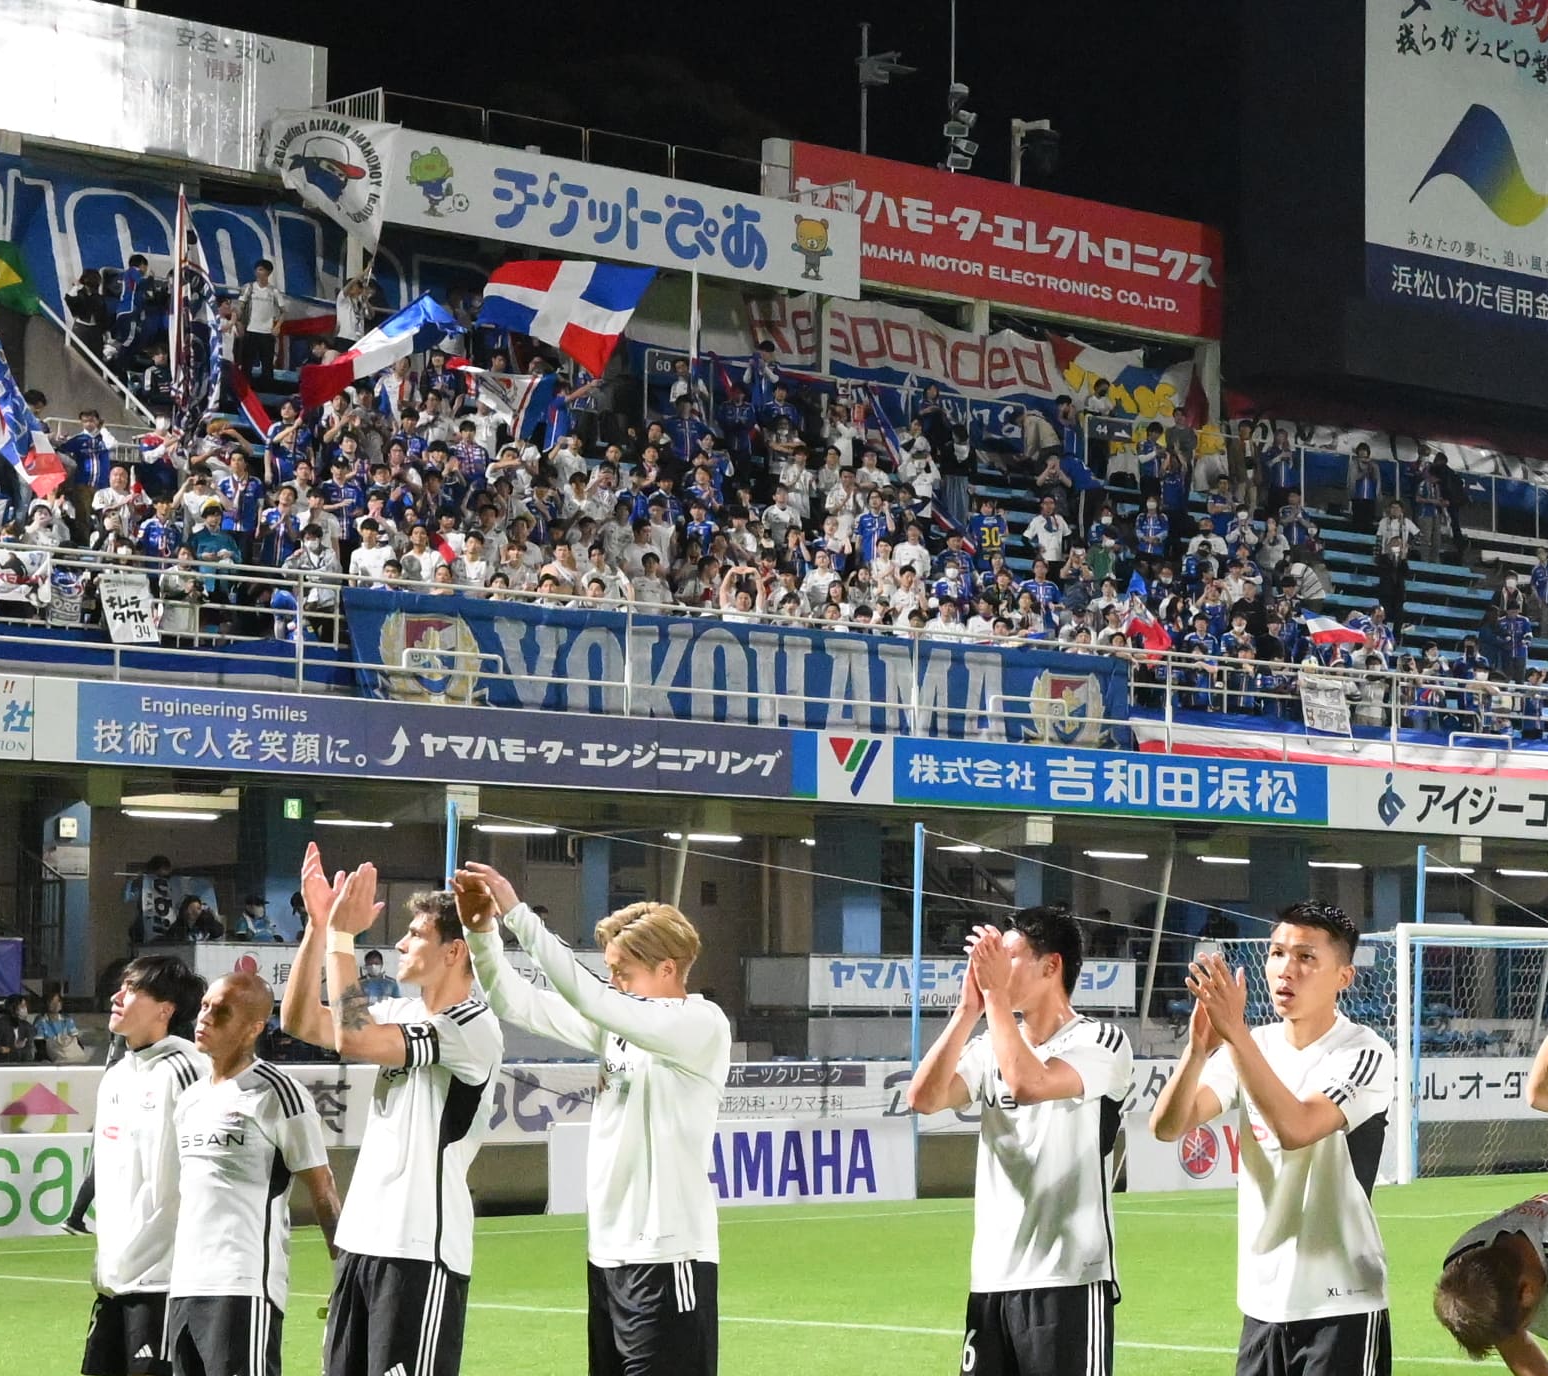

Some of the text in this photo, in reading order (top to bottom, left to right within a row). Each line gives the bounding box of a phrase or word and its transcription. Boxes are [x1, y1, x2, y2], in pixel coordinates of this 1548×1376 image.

[493, 167, 767, 272] チケットぴあ
[858, 244, 1180, 314] AMAHA MOTOR ELECTRONICS CO.,LTD.
[141, 697, 308, 723] Engineering Smiles
[494, 617, 1008, 742] YOKOHAMA
[92, 717, 369, 769] 技術で人を笑顔に。
[908, 753, 1298, 814] 株式会社 吉和田浜松
[180, 1133, 245, 1149] SSAN
[708, 1128, 877, 1198] AMAHA
